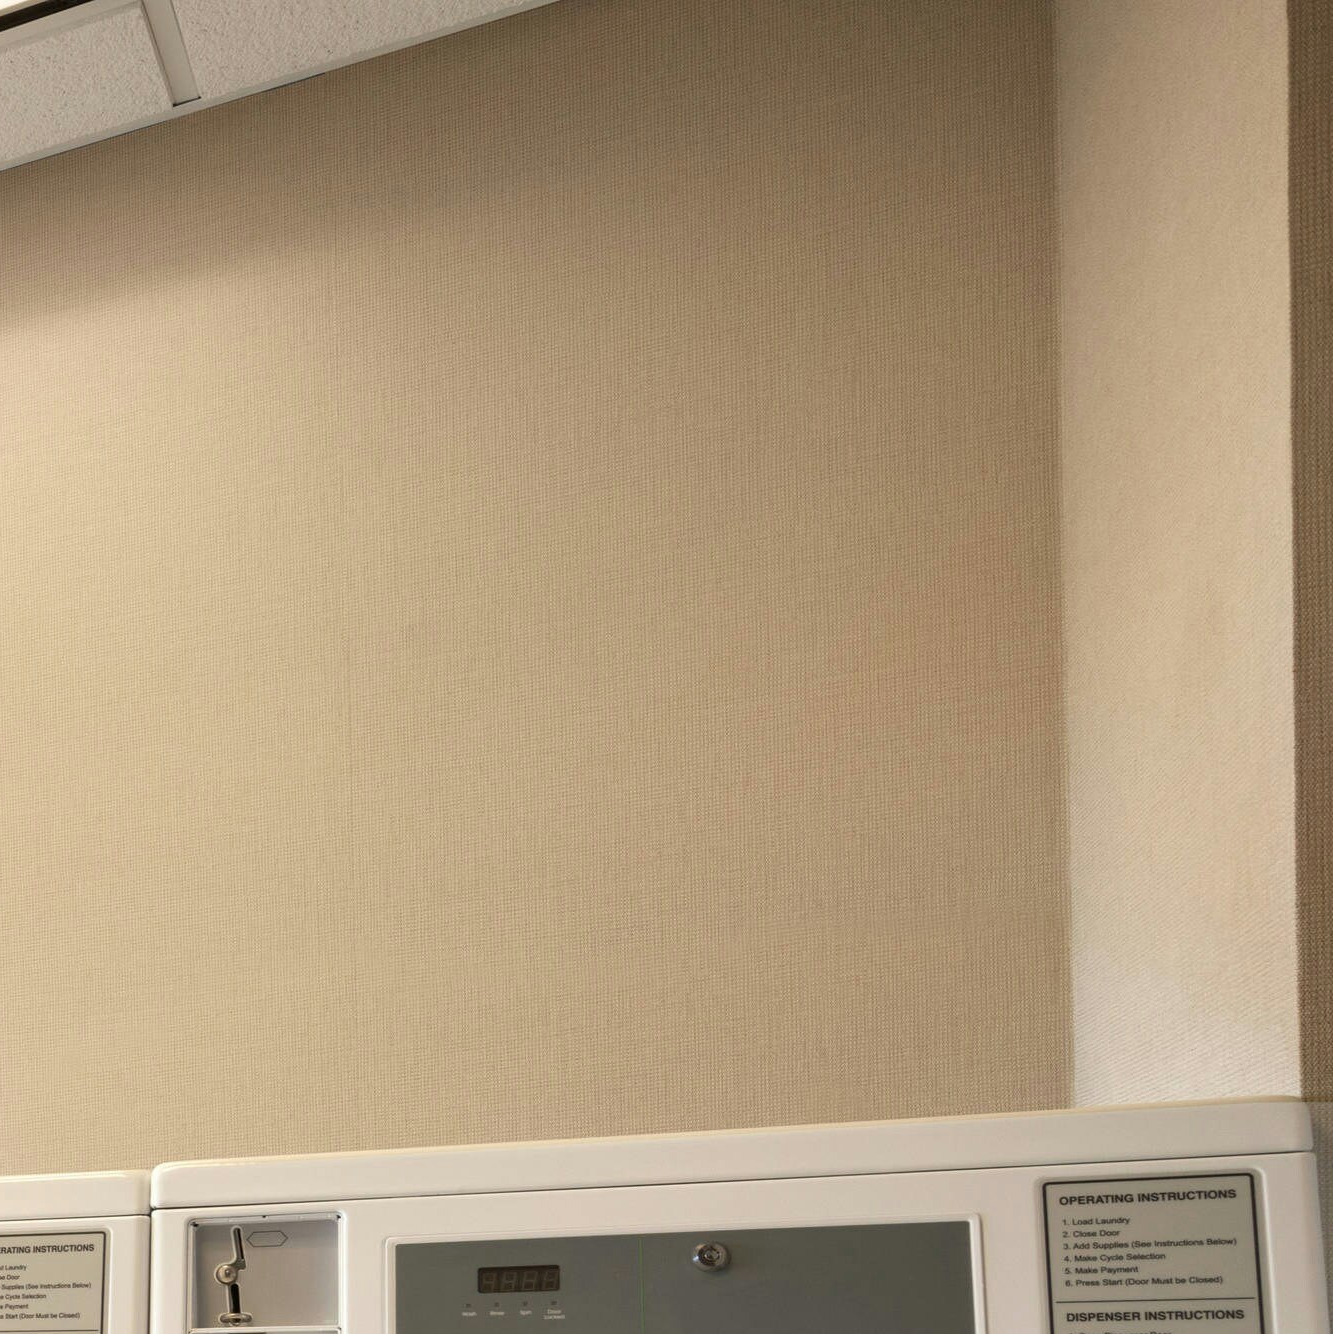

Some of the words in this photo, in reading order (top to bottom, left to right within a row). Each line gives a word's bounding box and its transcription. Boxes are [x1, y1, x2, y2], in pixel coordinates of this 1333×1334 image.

[1059, 1193, 1134, 1206] OPERATING
[1137, 1189, 1237, 1203] INSTRUCTIONS
[1072, 1218, 1093, 1226] Load
[1095, 1217, 1130, 1226] Laundry
[1073, 1230, 1097, 1238] Close
[1099, 1229, 1120, 1237] Door
[33, 1244, 94, 1254] INSTRUCTIONS
[1095, 1241, 1129, 1251] Supplies
[1131, 1241, 1152, 1250] (See
[1154, 1239, 1204, 1248] Instructions
[1207, 1238, 1237, 1247] Below)
[1100, 1254, 1123, 1263] Cycle
[1126, 1253, 1166, 1261] Selection
[1101, 1266, 1139, 1275] Payment
[1076, 1279, 1100, 1287] Press
[1125, 1278, 1149, 1287] (Door
[1151, 1277, 1173, 1285] Must
[1189, 1276, 1223, 1286] Closed)
[1066, 1312, 1141, 1322] DISPENSER
[1144, 1310, 1244, 1321] INSTRUCTIONS
